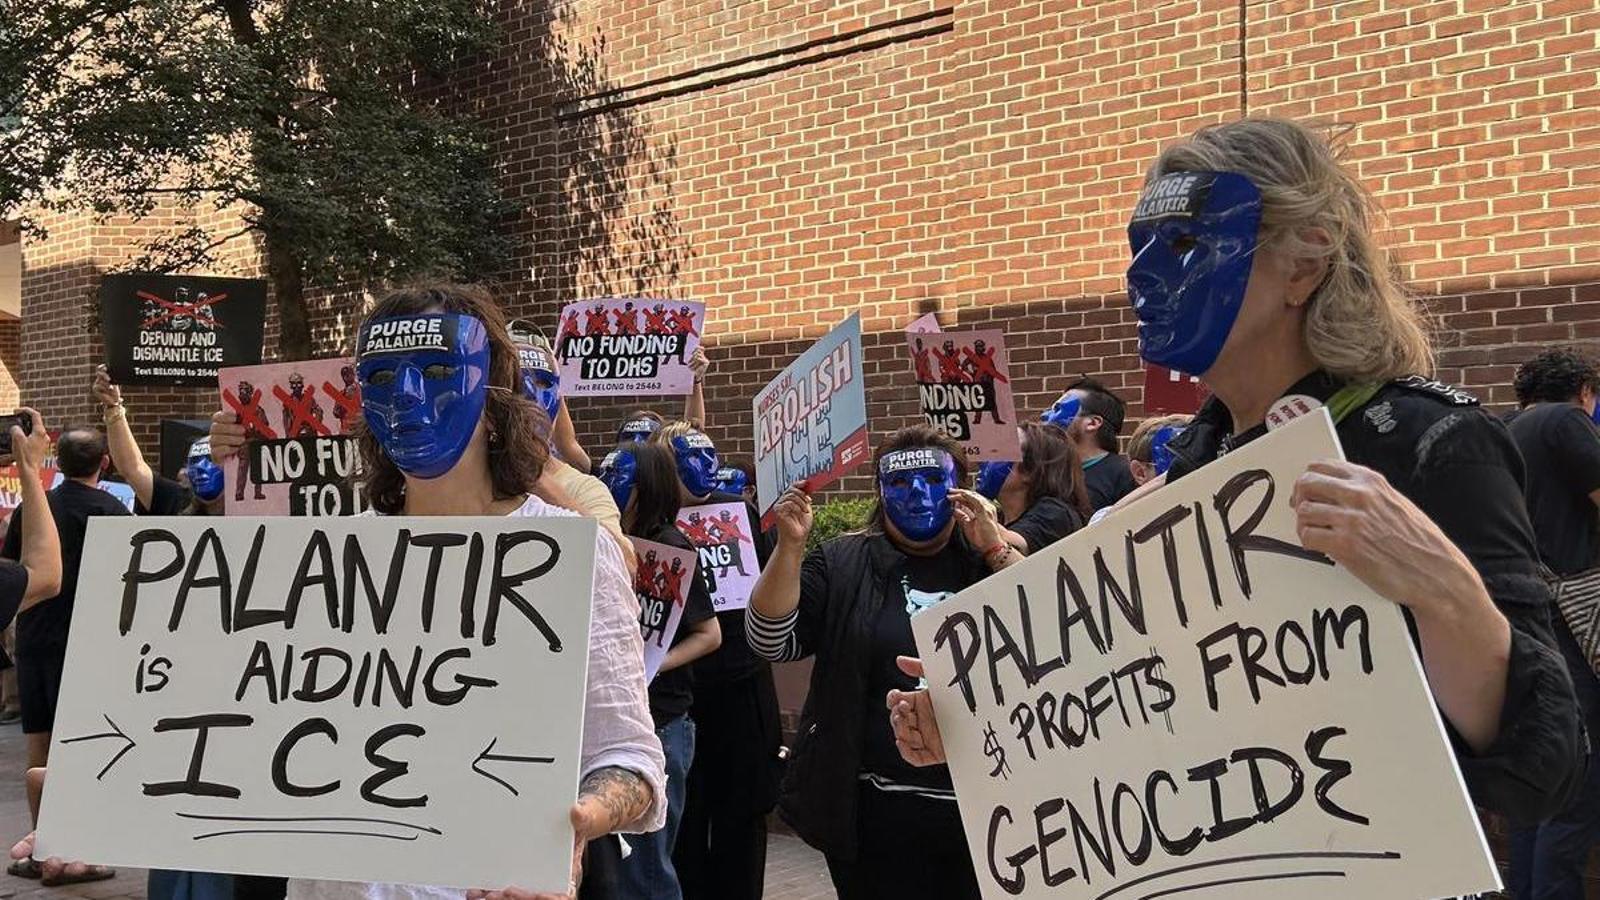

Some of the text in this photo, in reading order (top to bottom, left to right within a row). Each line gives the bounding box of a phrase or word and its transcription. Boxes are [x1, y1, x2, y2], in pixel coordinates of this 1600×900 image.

[1142, 176, 1197, 200] URGE
[1136, 196, 1189, 216] ALANTIR
[140, 330, 217, 346] DEFUND AND
[368, 317, 442, 339] PURGE
[133, 346, 224, 362] DISMANTLE ICE
[366, 334, 443, 351] PALANTIR
[567, 334, 678, 357] NO FUNDING
[519, 350, 546, 361] RGE
[153, 367, 186, 376] BELONG
[187, 368, 196, 376] to
[196, 368, 219, 377] 2546
[587, 356, 653, 379] TO DHS
[574, 382, 662, 391] Text BELONG to 25463
[920, 383, 986, 411] NDING
[758, 338, 853, 462] ABOLISH
[260, 439, 306, 481] NO
[888, 449, 933, 464] PURGE
[888, 457, 937, 470] PALANTIR
[299, 483, 342, 516] TO
[118, 524, 562, 652] PALANTIR
[933, 469, 1336, 714] PALANTIR
[136, 640, 499, 707] is AIDING
[983, 721, 1011, 780] $
[1196, 604, 1374, 711] FROM
[142, 713, 430, 808] ICE
[986, 726, 1370, 895] GENOCIDE
